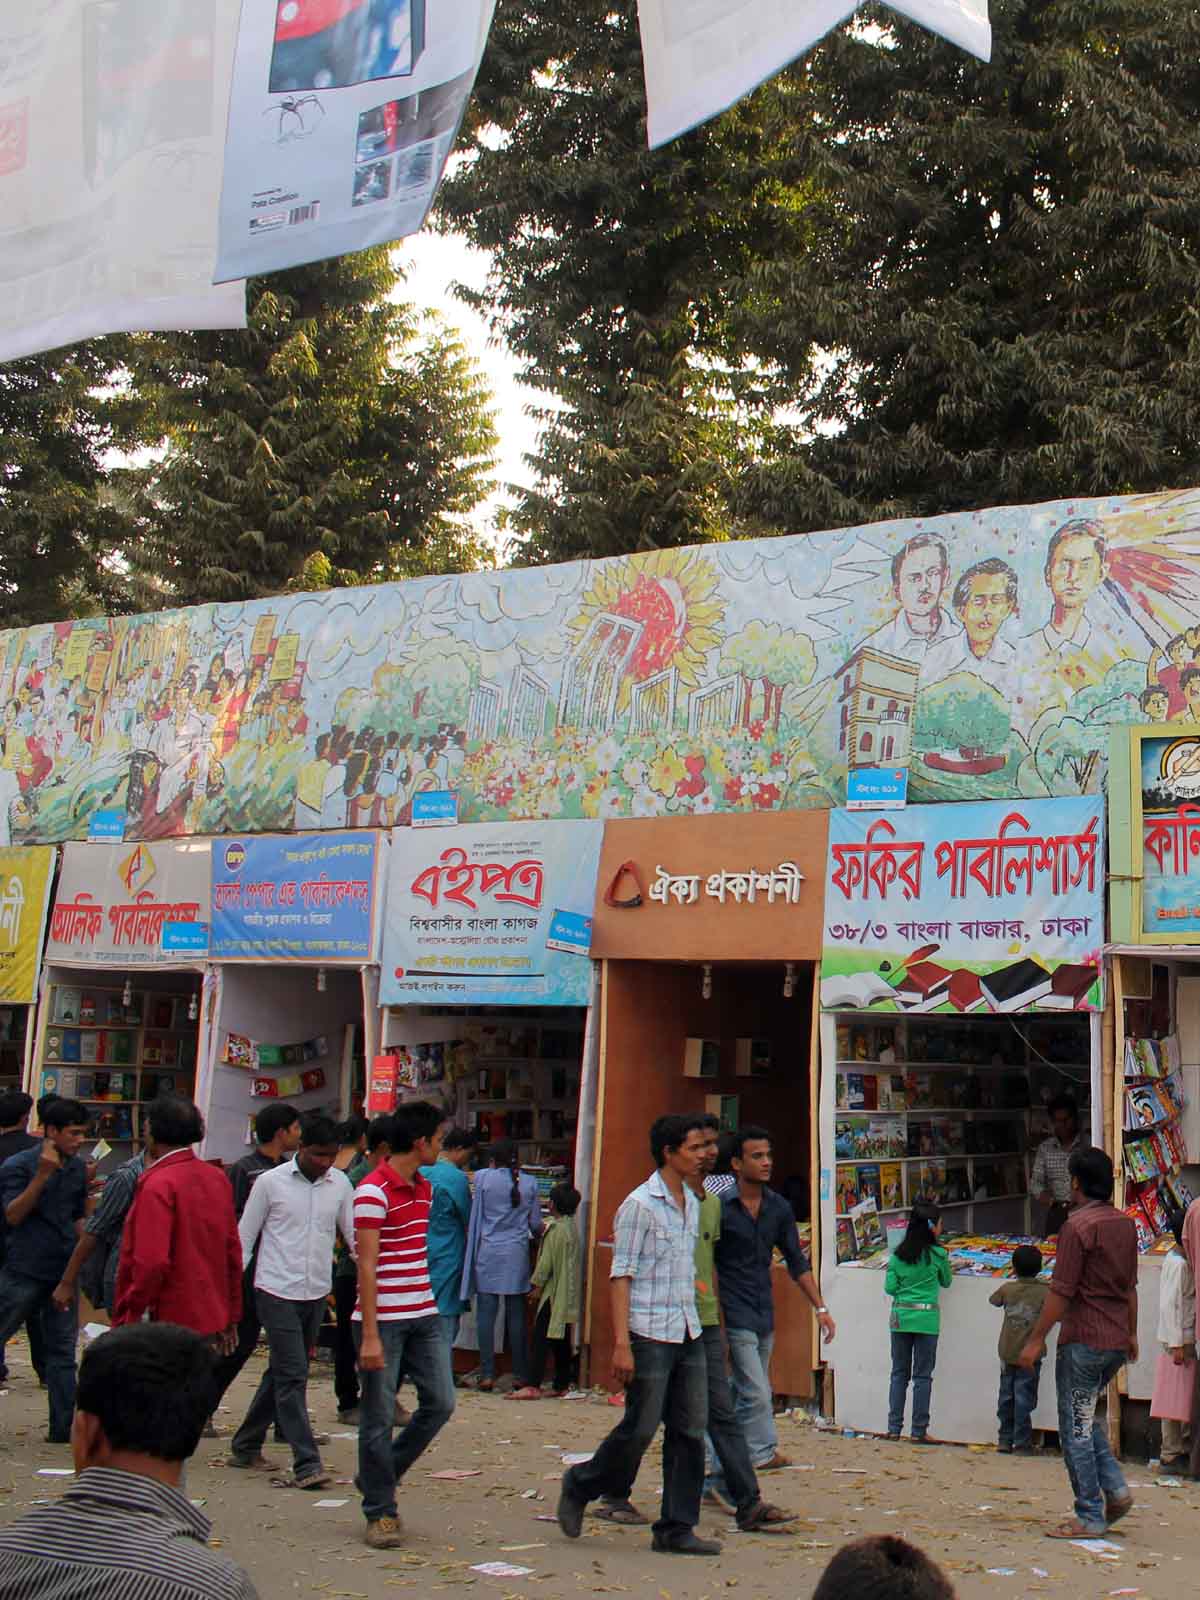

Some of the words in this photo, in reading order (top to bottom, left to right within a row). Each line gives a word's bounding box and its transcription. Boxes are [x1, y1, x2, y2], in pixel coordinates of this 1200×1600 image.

[831, 818, 925, 900] ফকির
[933, 811, 1100, 898] পাবলিশার্স
[410, 846, 544, 911] বইপত্র
[649, 864, 701, 904] ঐক্য
[705, 862, 805, 904] প্রকাশনী
[467, 917, 499, 932] বাংলা
[502, 917, 539, 931] কাগজ
[828, 919, 888, 944] ৩৮/৩
[896, 920, 953, 942] বাংলা
[958, 919, 1032, 944] বাজার,
[1040, 915, 1093, 938] ঢাকা
